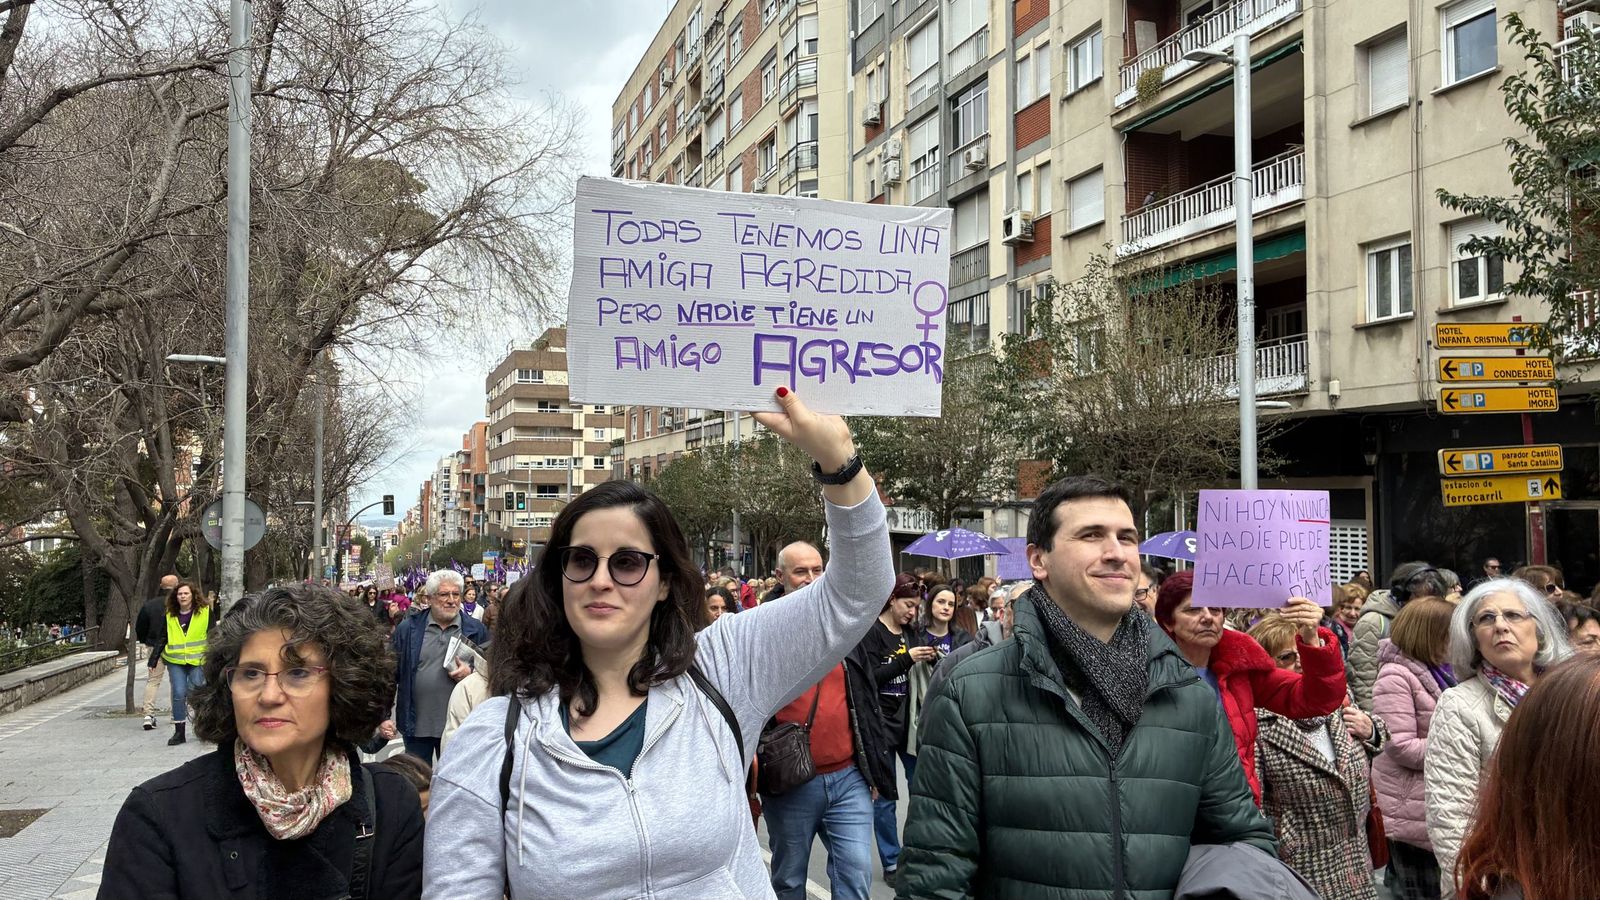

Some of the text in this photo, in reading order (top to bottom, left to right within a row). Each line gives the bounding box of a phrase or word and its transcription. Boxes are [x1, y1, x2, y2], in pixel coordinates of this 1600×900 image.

[592, 209, 941, 255] TODAS TENEMOS UNA
[741, 252, 912, 295] AGREDIDA
[596, 297, 662, 327] PERO
[846, 309, 874, 325] UN
[1439, 327, 1463, 335] HOTEL
[1440, 335, 1508, 344] INFANTA CRISTINA
[753, 333, 943, 393] AGRESOR
[1525, 360, 1552, 369] HOTEL
[1493, 369, 1553, 378] CONDESTABLE
[1528, 390, 1554, 398] HOTEL
[1528, 400, 1555, 408] IMORA
[1501, 449, 1558, 460] parador Castillo
[1507, 458, 1559, 468] Santa Catalina
[1483, 480, 1493, 488] de
[1446, 490, 1503, 503] ferrocarril
[1236, 499, 1277, 523] HOY
[1280, 530, 1323, 550] PUEDE
